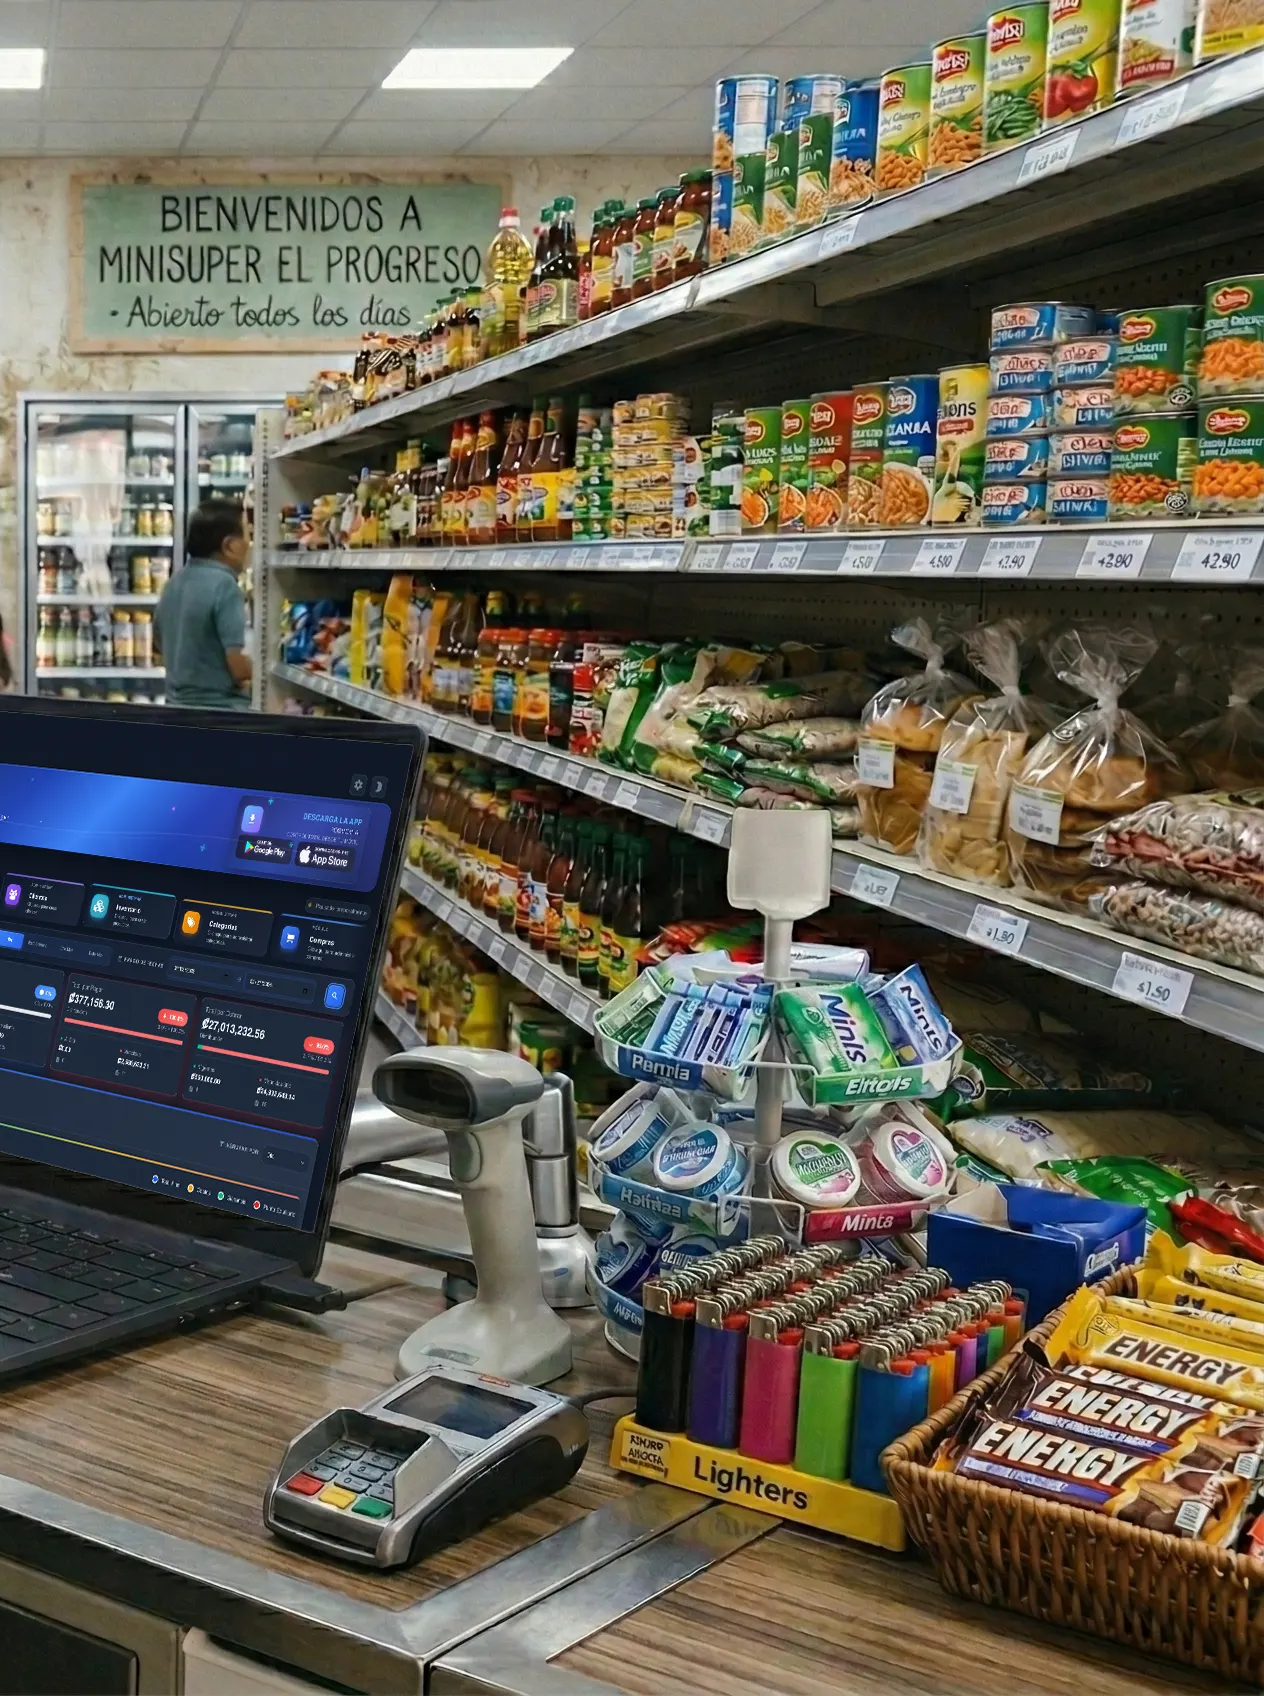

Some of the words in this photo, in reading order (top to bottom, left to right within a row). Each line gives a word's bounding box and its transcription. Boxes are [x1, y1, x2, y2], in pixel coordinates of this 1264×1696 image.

[161, 195, 383, 233] BIENVENIDOS
[400, 195, 423, 232] A
[99, 245, 262, 284] MINISUPER
[278, 246, 313, 283] EL
[327, 245, 482, 284] PROGRESO
[126, 295, 225, 328] Abierto
[231, 297, 301, 328] todos
[313, 297, 349, 328] los
[360, 297, 411, 328] días
[311, 854, 327, 866] App
[329, 855, 348, 867] Store
[1104, 1335, 1248, 1387] ENERGY
[1033, 1379, 1209, 1438] ENERGY
[973, 1420, 1154, 1487] ENERGY
[694, 1455, 808, 1510] Lighters
